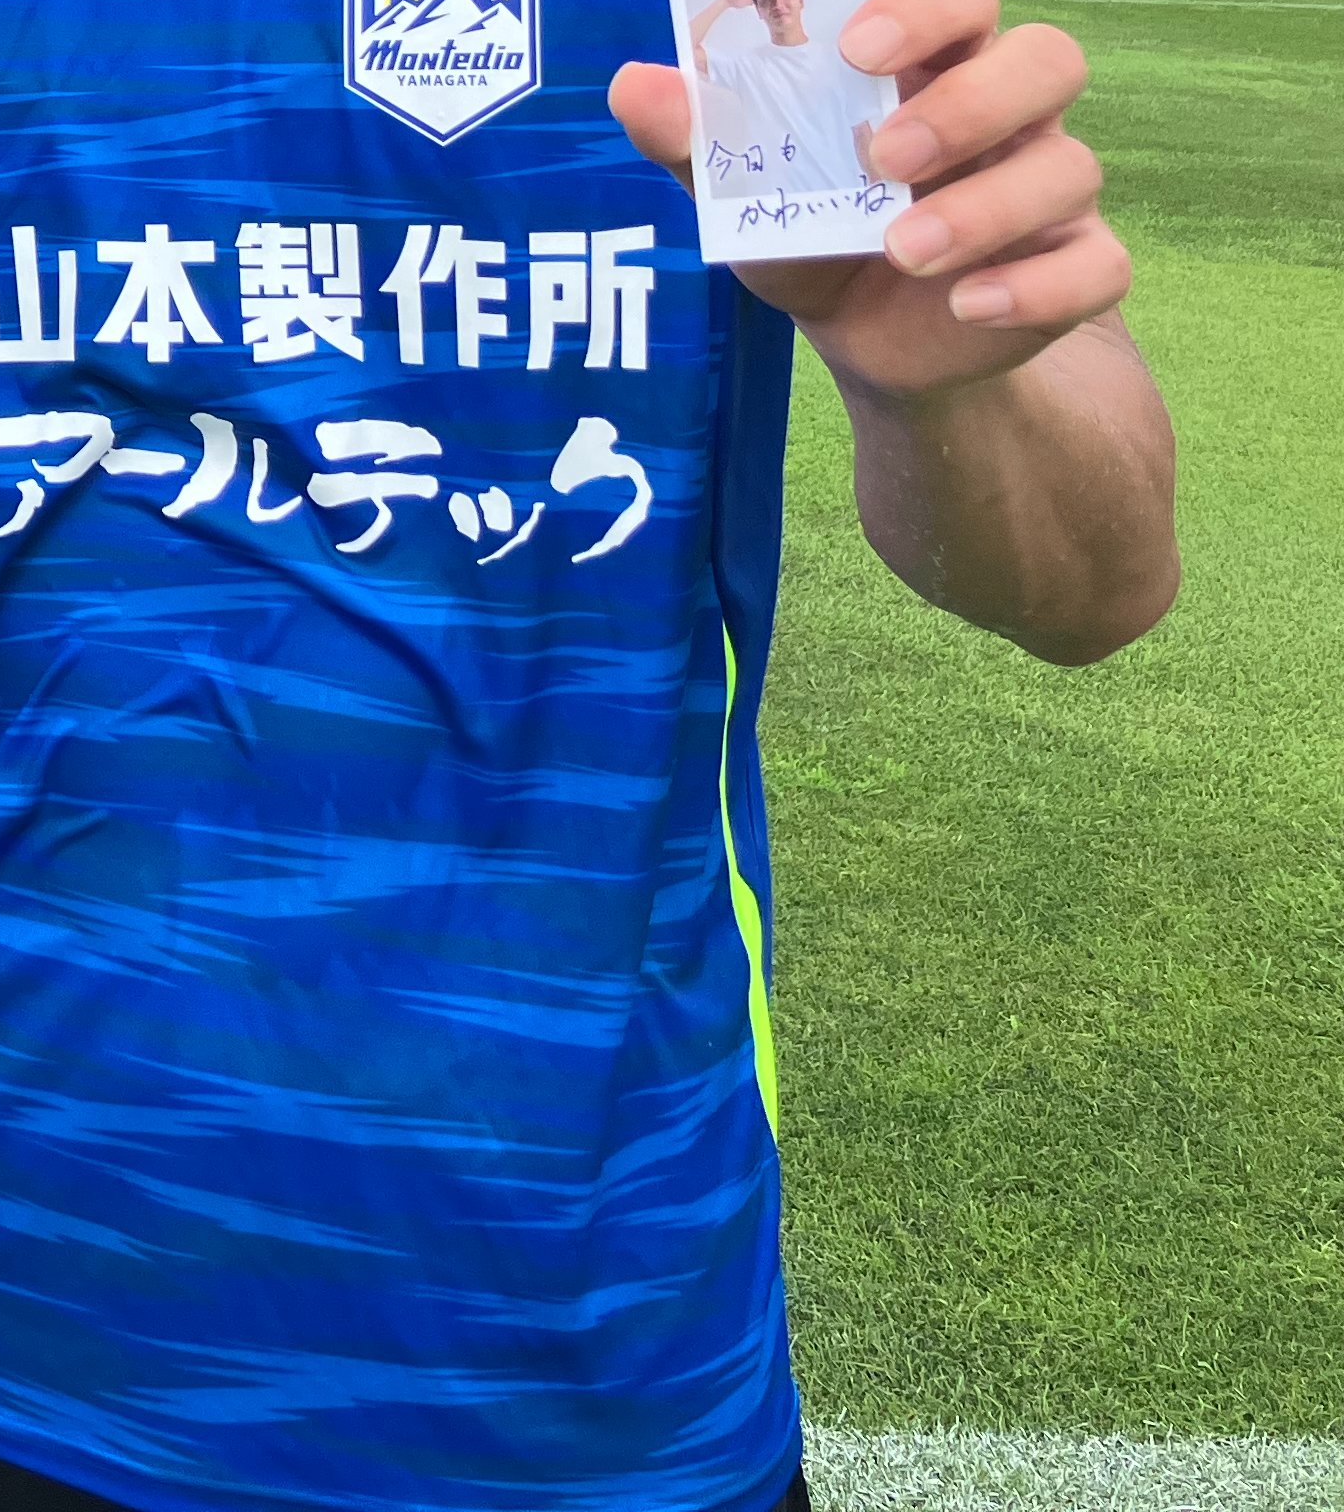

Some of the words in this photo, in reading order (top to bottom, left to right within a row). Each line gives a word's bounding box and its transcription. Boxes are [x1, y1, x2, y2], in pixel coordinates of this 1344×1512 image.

[359, 38, 525, 71] Montedio
[396, 74, 488, 87] YAMAGATA
[737, 174, 895, 233] かわいいね
